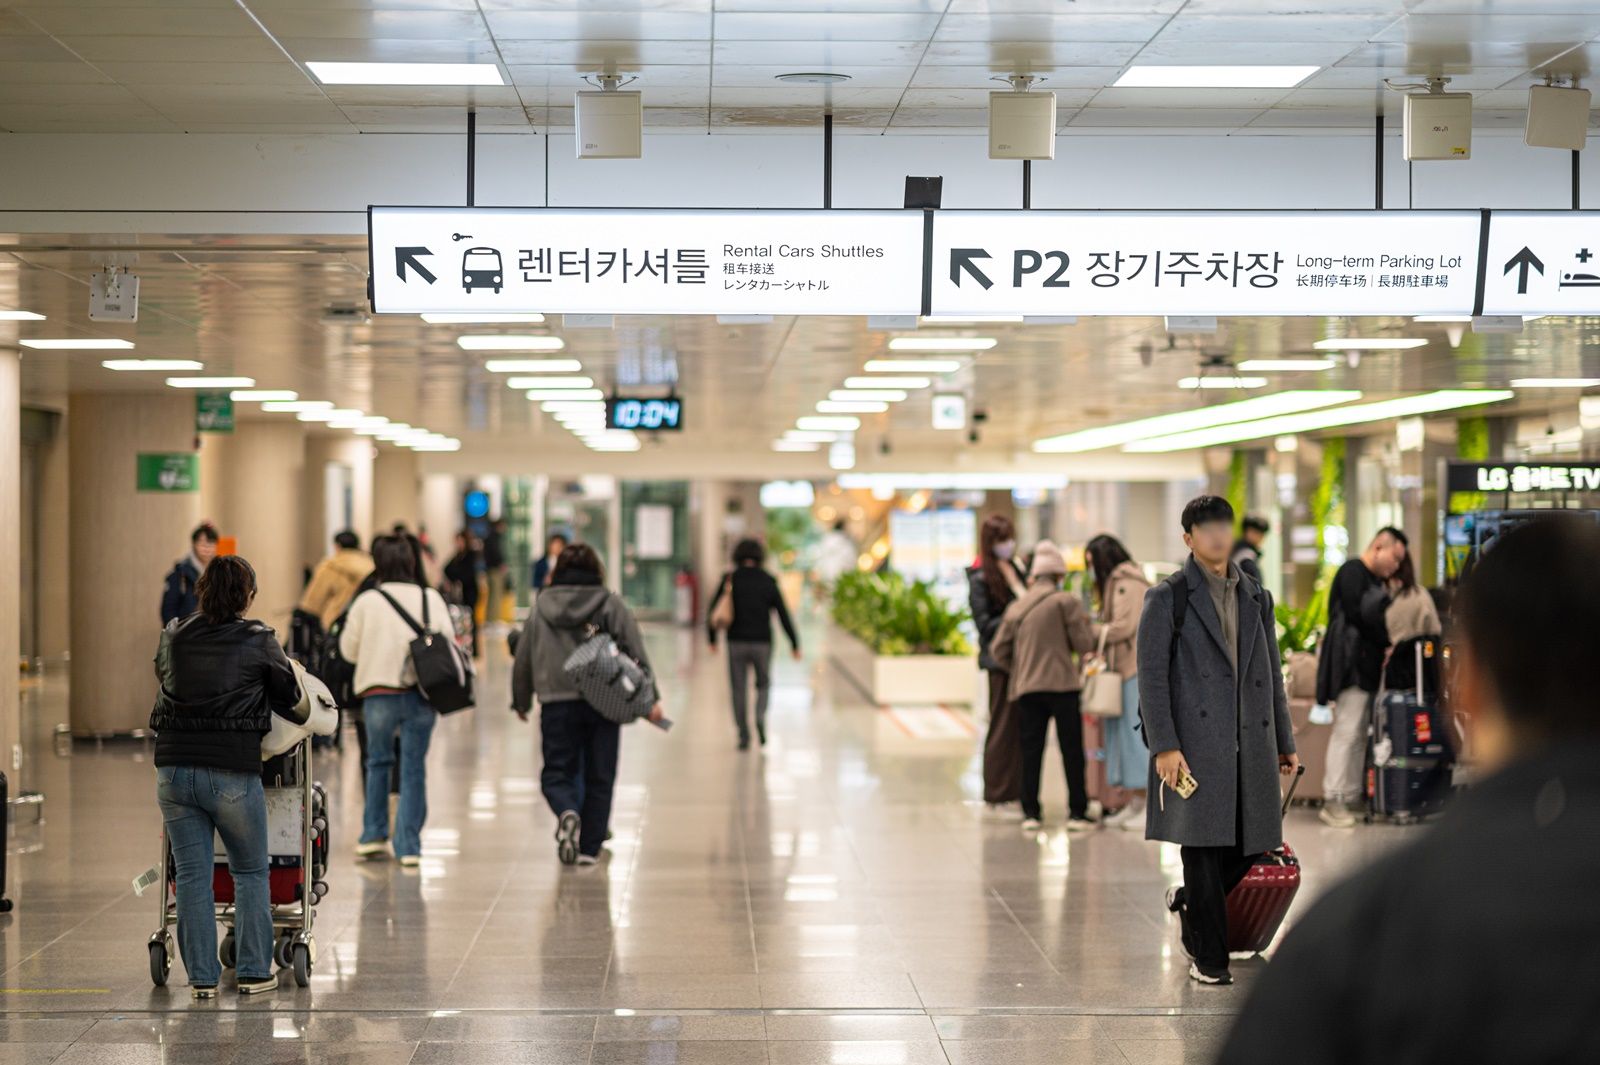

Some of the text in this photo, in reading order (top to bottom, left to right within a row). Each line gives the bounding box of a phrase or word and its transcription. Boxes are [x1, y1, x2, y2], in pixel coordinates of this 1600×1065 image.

[723, 244, 884, 258] Rental Cars Shuttles
[518, 247, 711, 285] 렌터카셔틀
[722, 262, 775, 275] 租车接送
[1012, 249, 1071, 288] P2
[1085, 250, 1285, 289] 장기주차장
[1296, 253, 1462, 271] Long-term Parking Lot
[723, 278, 830, 292] レンタカーシャトル
[1295, 273, 1367, 288] 长期停车场
[1377, 274, 1449, 288] 長期駐車場
[614, 400, 679, 428] 10:04
[1477, 467, 1508, 490] LG
